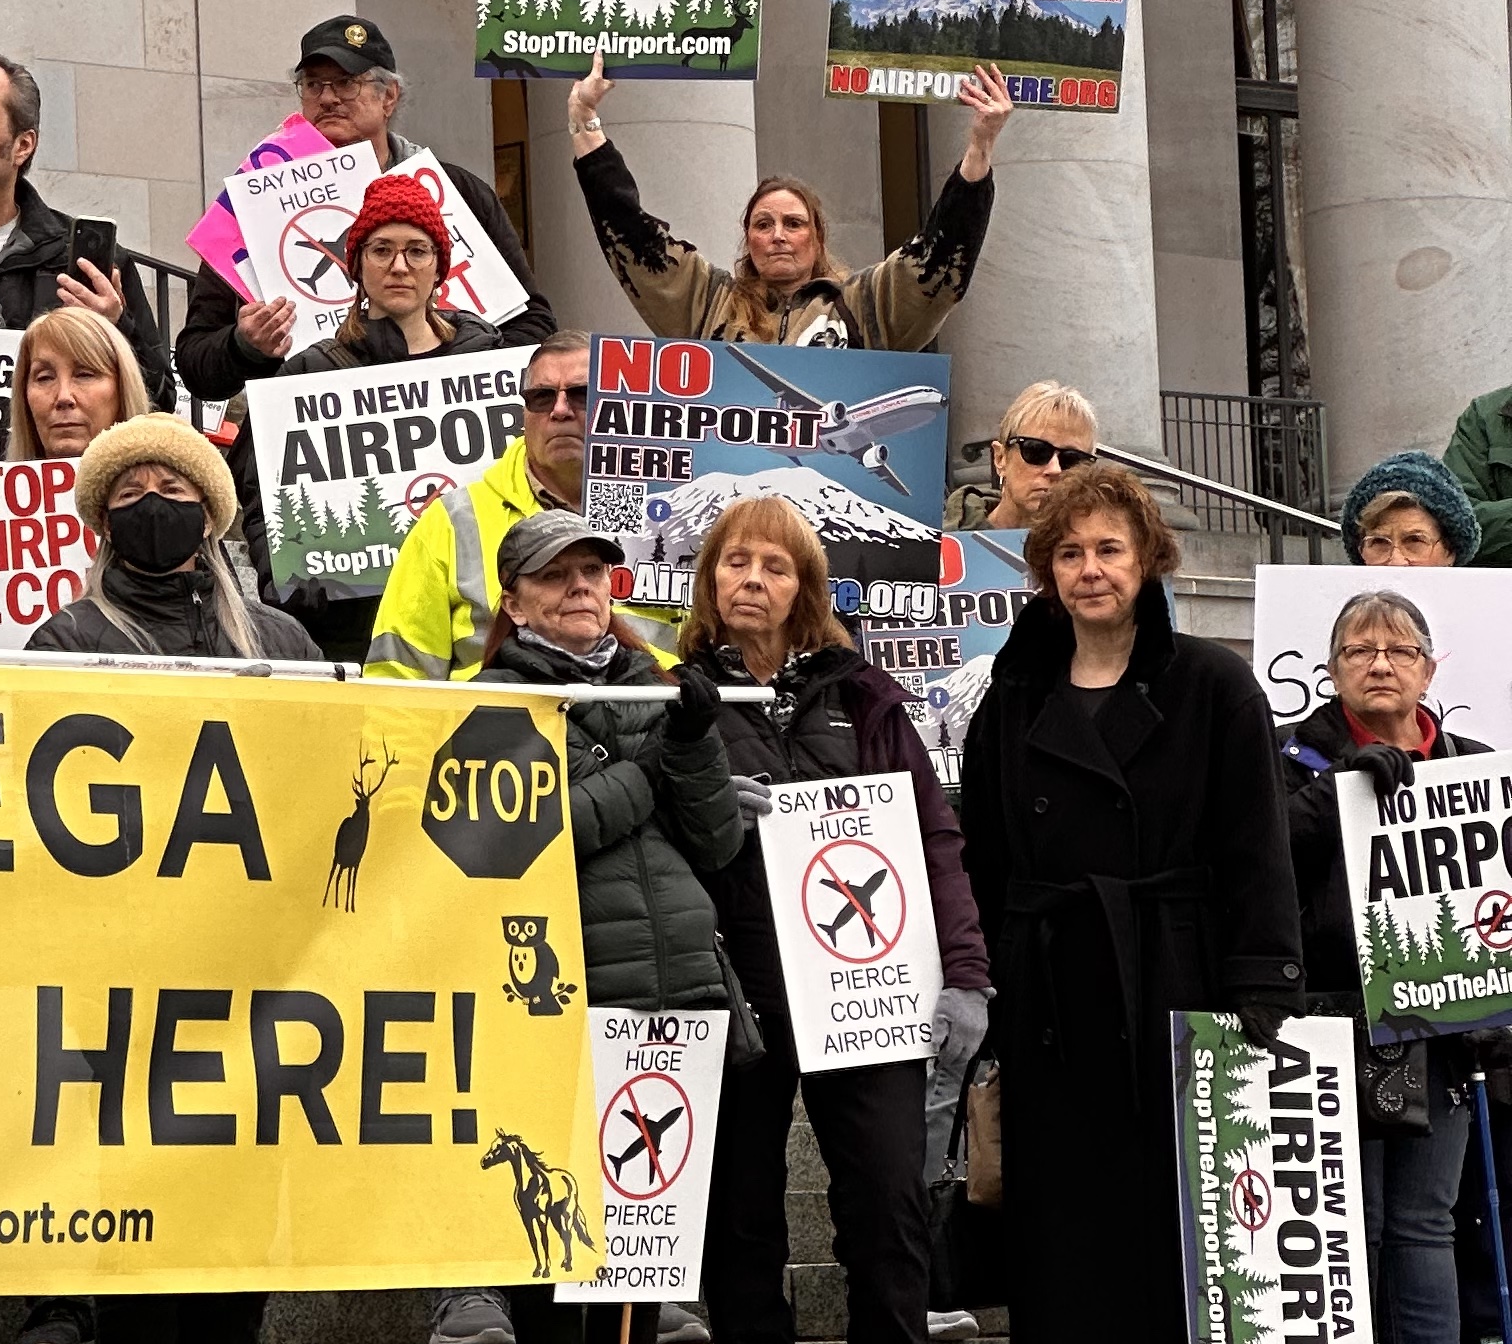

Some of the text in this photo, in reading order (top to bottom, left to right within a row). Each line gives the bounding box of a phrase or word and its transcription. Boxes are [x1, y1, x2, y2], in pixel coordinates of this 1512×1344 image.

[503, 30, 731, 58] StopTheAirport.com
[247, 154, 356, 195] SAY NO TO
[279, 184, 340, 214] HUGE
[597, 337, 714, 398] NO
[294, 392, 342, 423] NO
[353, 380, 429, 413] NEW
[591, 398, 827, 449] AIRPORT
[280, 403, 525, 486] AIRPOR
[589, 444, 692, 481] HERE
[869, 635, 962, 671] HERE
[430, 759, 556, 824] STOP
[778, 783, 894, 814] SAY NO TO
[1376, 789, 1417, 826] NO
[1425, 778, 1491, 819] NEW
[810, 816, 873, 841] HUGE
[830, 964, 911, 992] PIERCE
[831, 993, 920, 1022] COUNTY
[604, 1017, 709, 1043] SAY NO TO
[824, 1023, 932, 1056] AIRPORTS
[31, 984, 479, 1147] HERE!
[625, 1050, 683, 1072] HUGE
[604, 1205, 677, 1226] PIERCE
[1316, 1066, 1355, 1340] NO NEW MEGA
[605, 1235, 680, 1256] OUNTY
